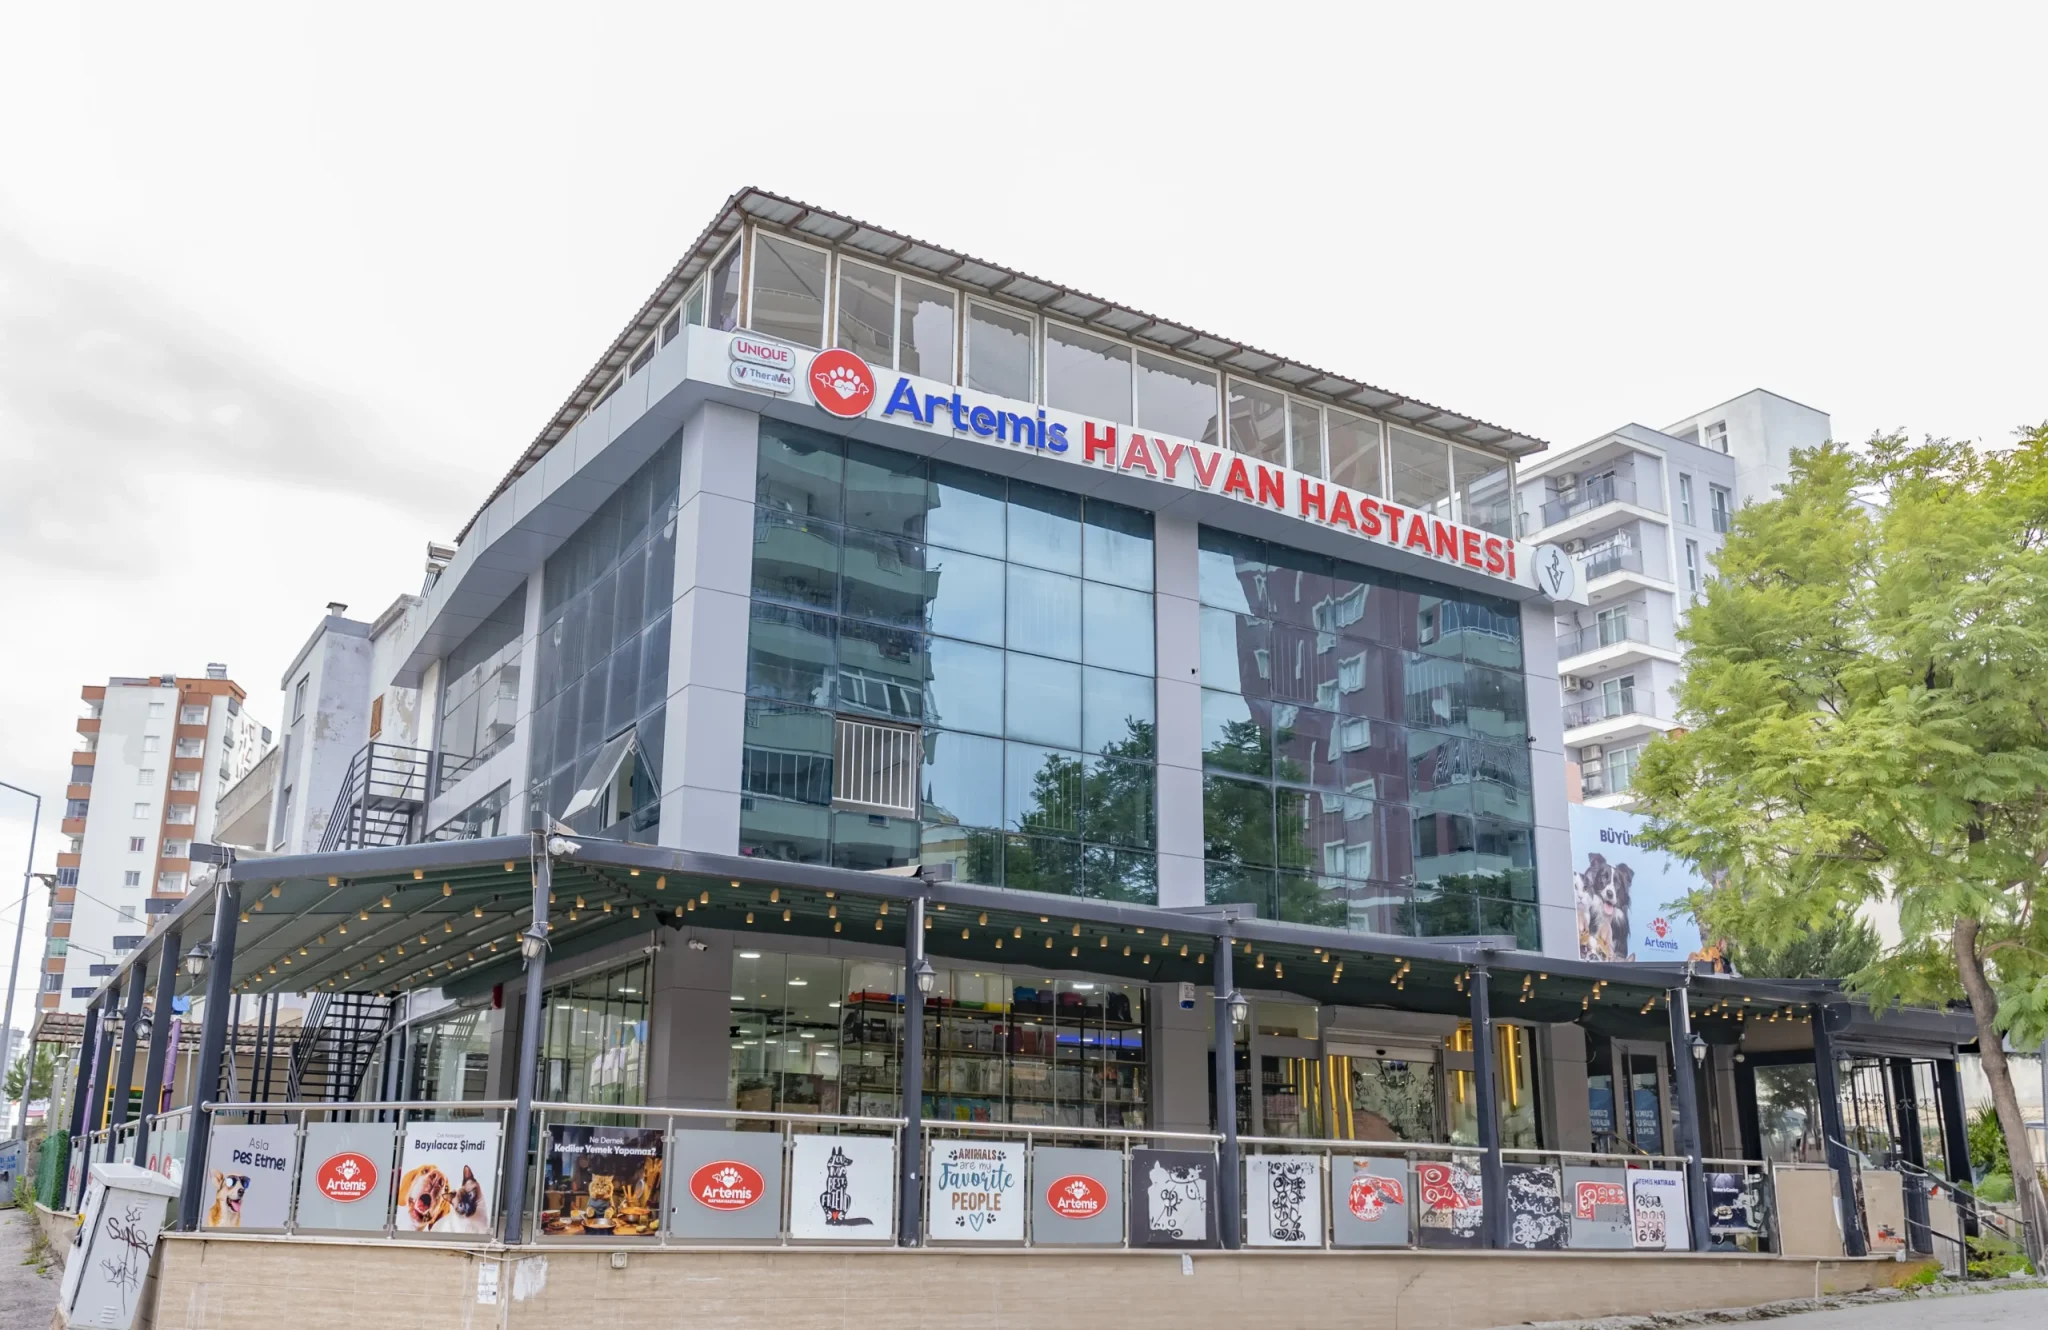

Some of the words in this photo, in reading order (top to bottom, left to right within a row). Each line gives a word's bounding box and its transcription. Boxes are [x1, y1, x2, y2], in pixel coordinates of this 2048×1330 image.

[737, 340, 788, 362] UNIQUE
[750, 368, 791, 385] TheraVet
[881, 377, 1069, 455] Artemis
[1082, 421, 1285, 511] HAYVAN
[1645, 936, 1679, 950] Artemis
[248, 1137, 270, 1151] Asla
[414, 1139, 458, 1152] Bayılacaz
[460, 1140, 486, 1153] Şimdi
[589, 1136, 599, 1144] Ne
[600, 1136, 624, 1145] Demek
[554, 1143, 584, 1153] Kediler
[585, 1144, 613, 1154] Yemek
[613, 1145, 657, 1157] Yapamaz?
[958, 1148, 997, 1161] ANIMALS
[232, 1149, 252, 1166] Pes
[254, 1153, 286, 1172] Etme!
[959, 1161, 976, 1170] are
[979, 1162, 992, 1173] my
[326, 1178, 367, 1191] Artemis
[938, 1163, 1015, 1193] Favorite
[702, 1185, 752, 1199] Artemis
[951, 1192, 1002, 1212] PEOPLE
[1057, 1196, 1098, 1210] Artemis
